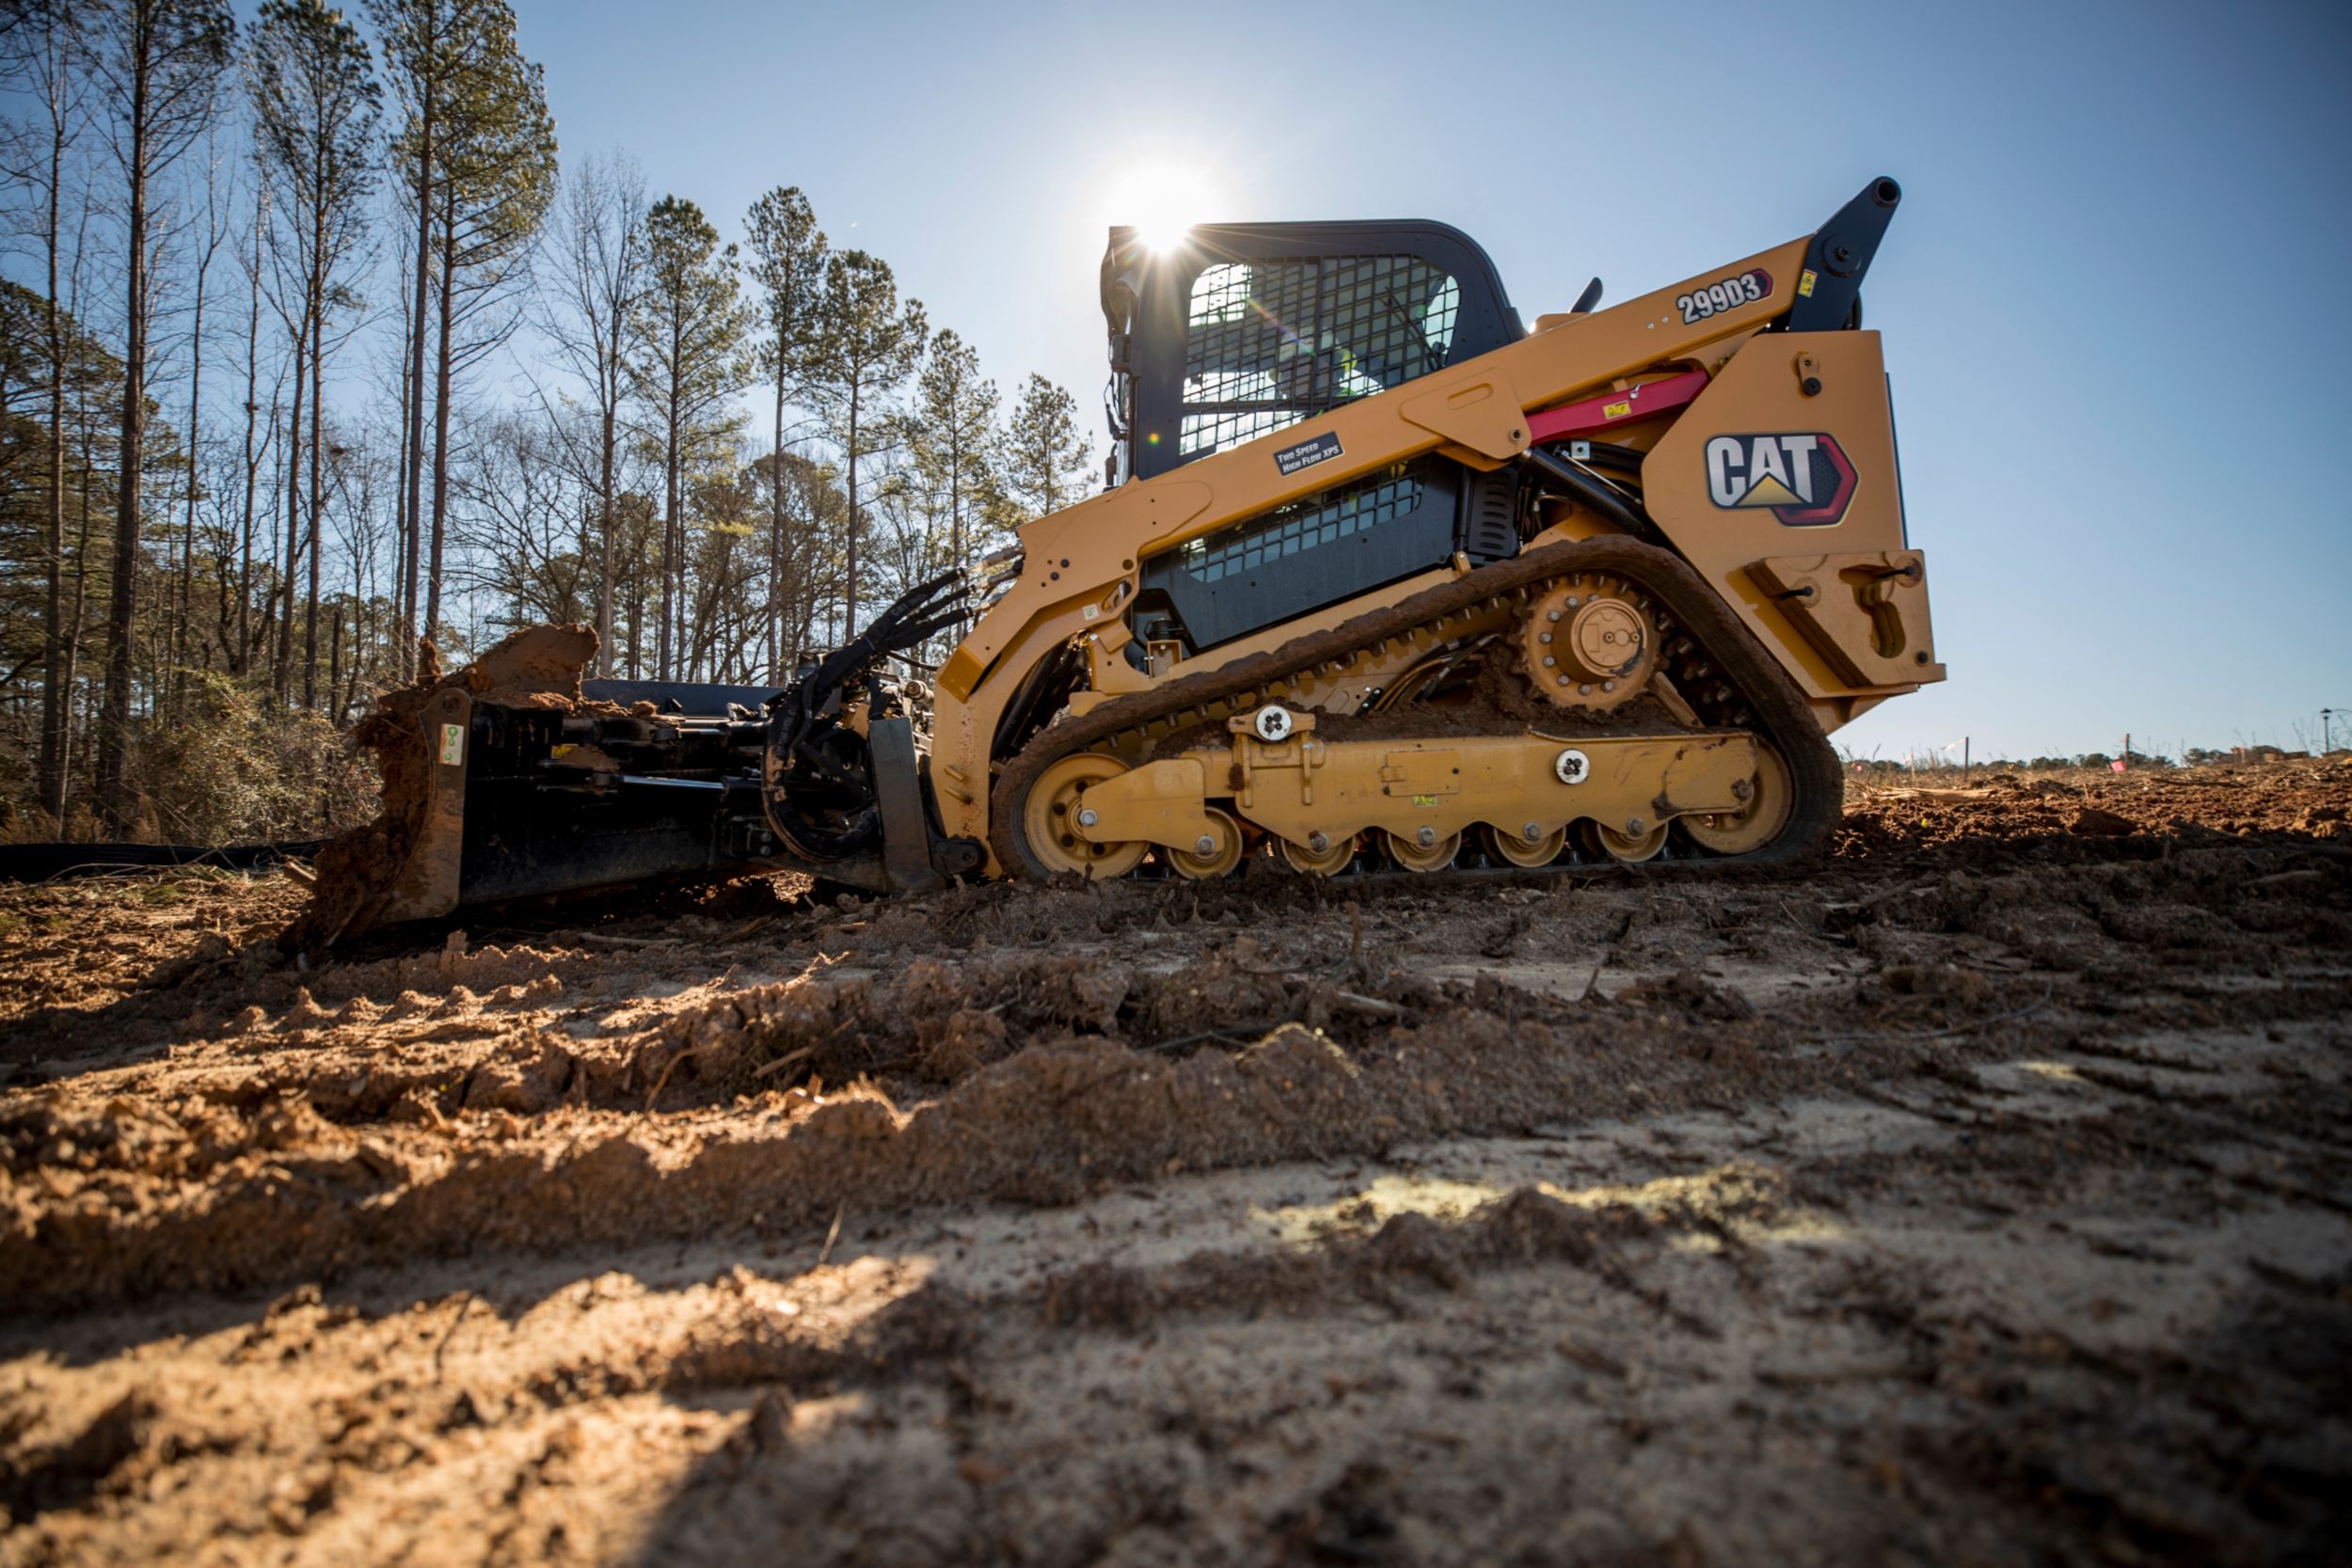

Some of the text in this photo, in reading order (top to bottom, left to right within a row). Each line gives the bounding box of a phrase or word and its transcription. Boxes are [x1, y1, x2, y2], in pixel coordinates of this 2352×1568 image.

[1677, 273, 1761, 324] 299D3
[1323, 445, 1340, 458] XPS
[1707, 436, 1818, 507] CAT
